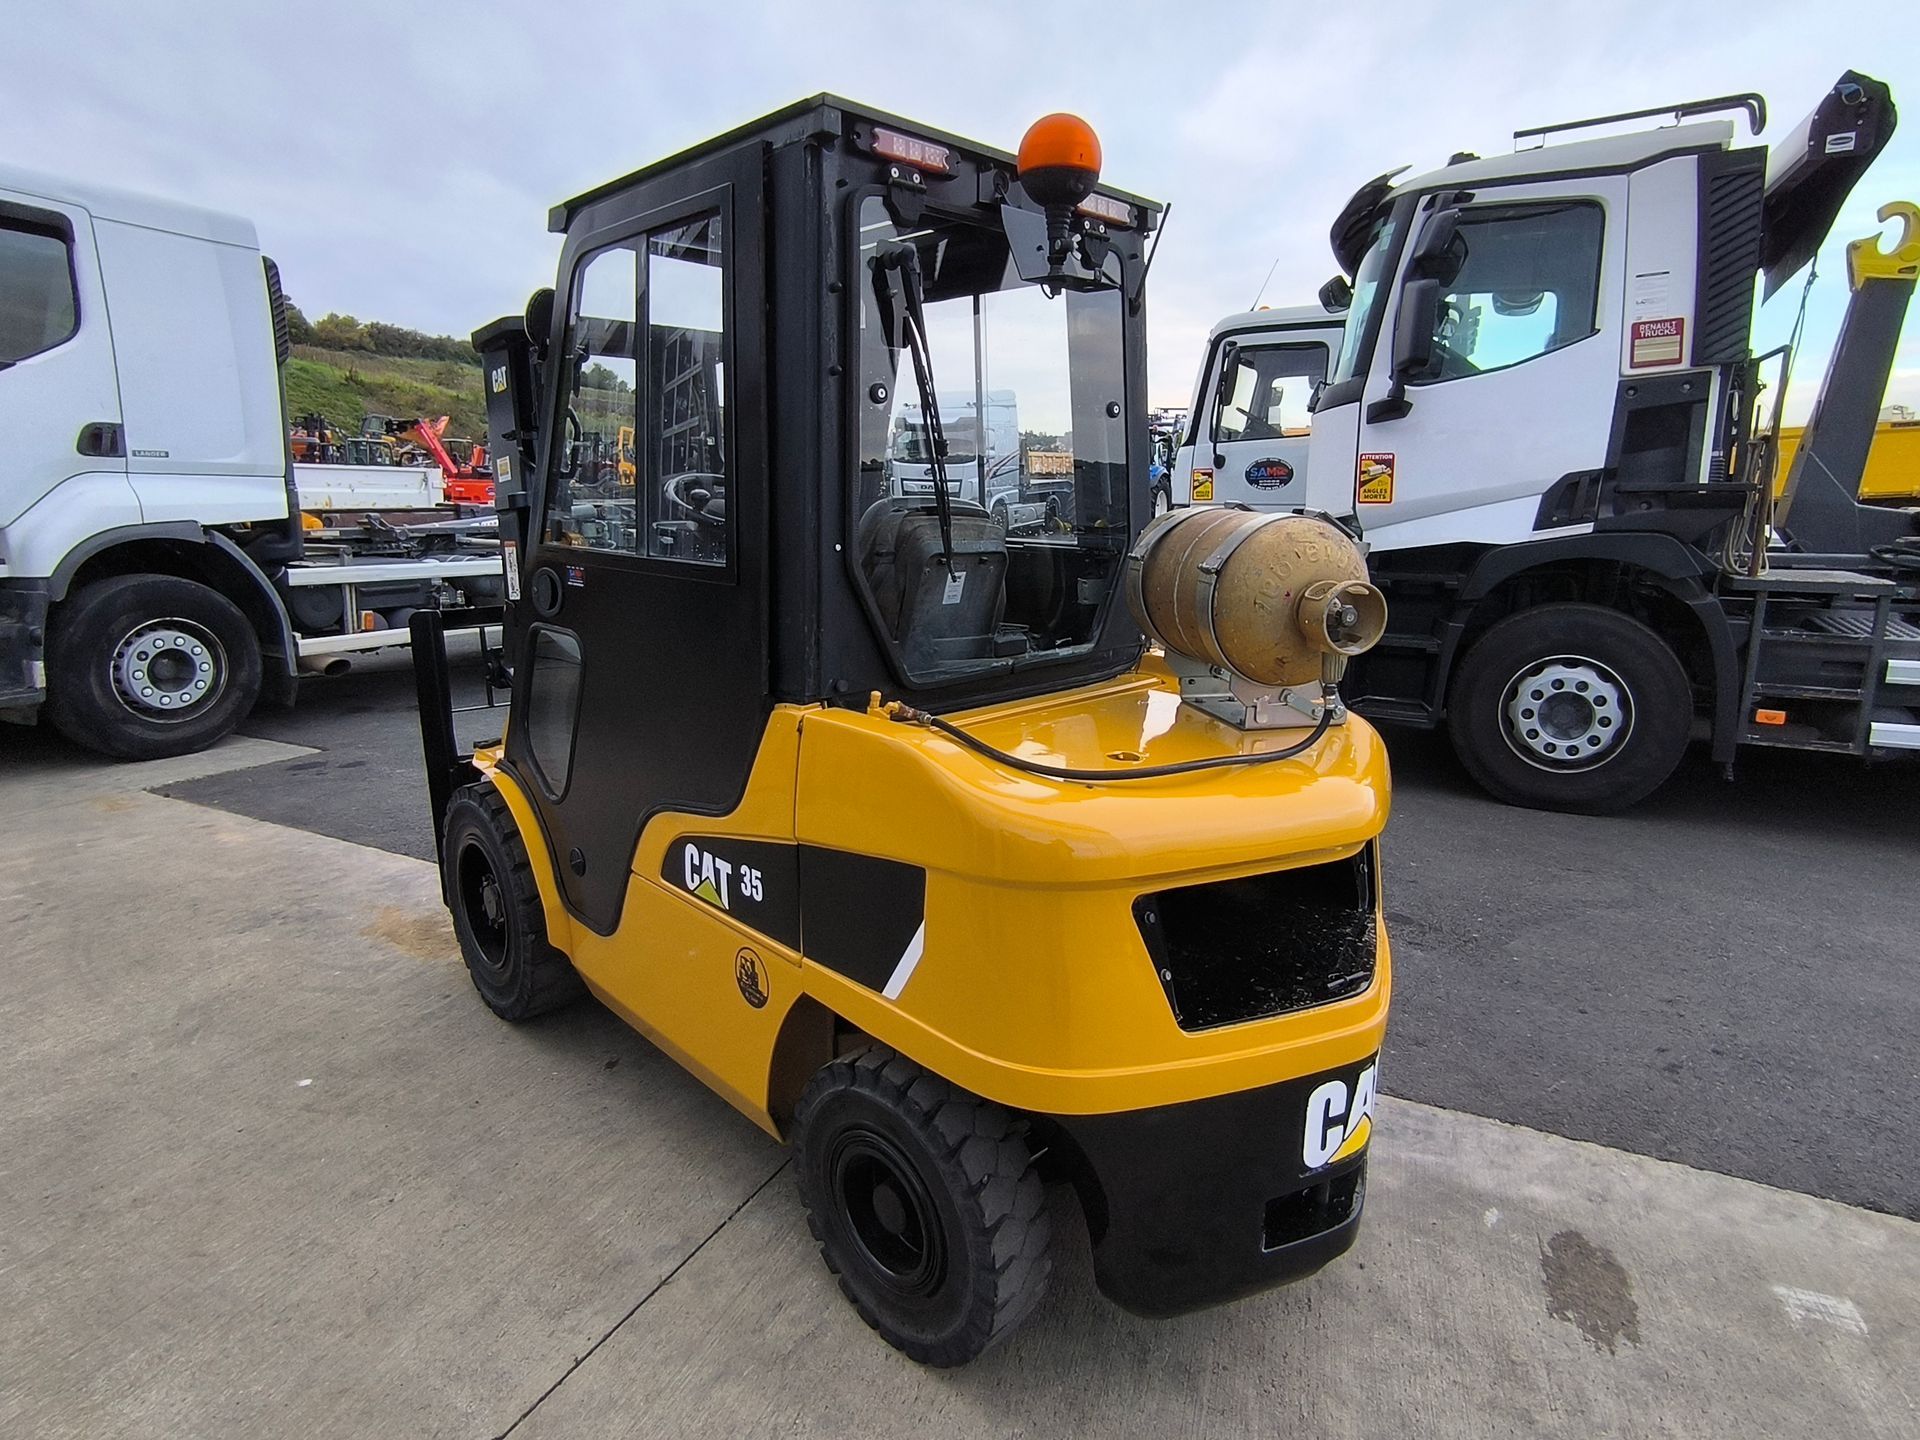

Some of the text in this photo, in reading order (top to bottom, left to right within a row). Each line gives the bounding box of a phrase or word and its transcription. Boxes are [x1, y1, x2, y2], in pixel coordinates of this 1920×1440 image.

[1640, 321, 1677, 332] RENAULT
[1641, 328, 1677, 338] TRUCKS
[492, 366, 507, 393] CAT
[685, 843, 764, 911] CAT 35
